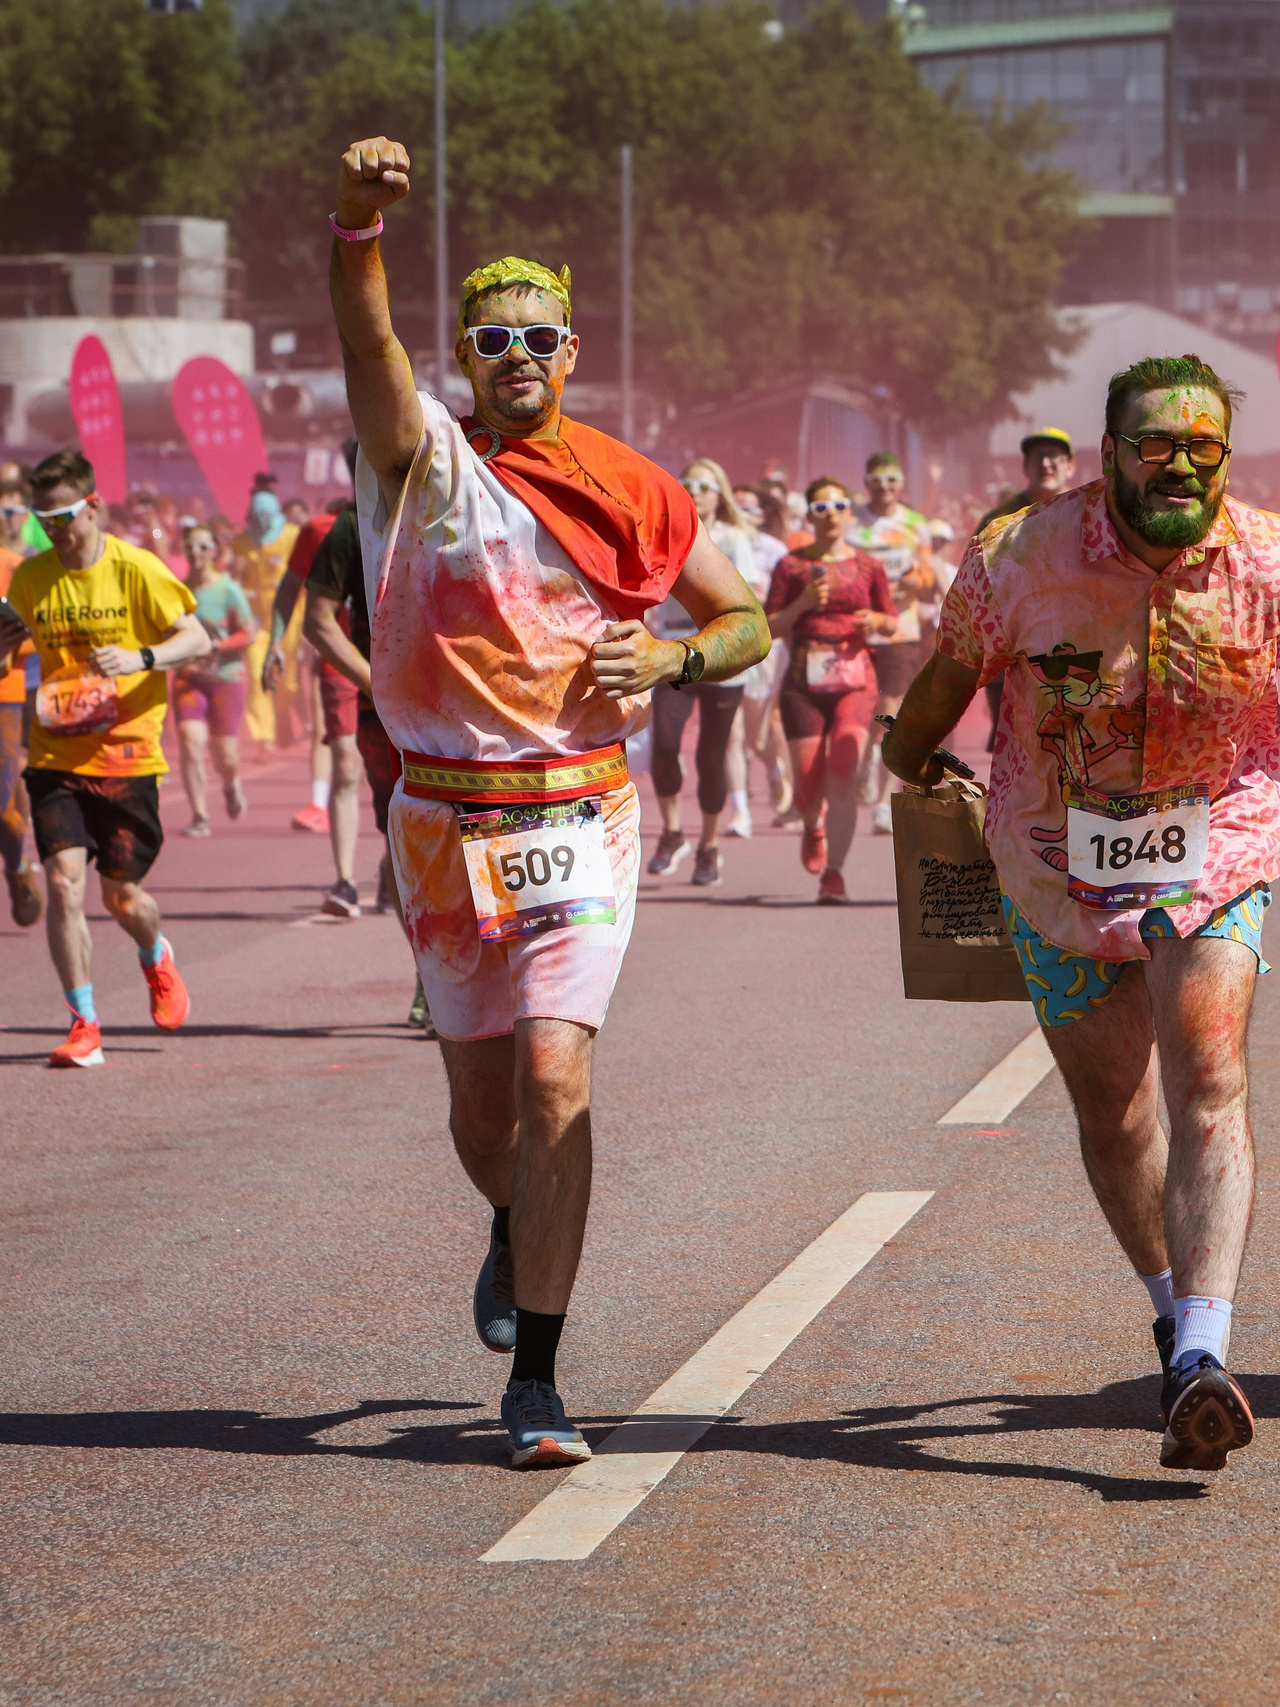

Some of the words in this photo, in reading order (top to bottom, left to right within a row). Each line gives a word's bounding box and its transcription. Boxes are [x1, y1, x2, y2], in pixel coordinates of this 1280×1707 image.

[1083, 783, 1197, 813] КРАСОЧНЫЙ
[1147, 796, 1206, 816] 2026
[1090, 825, 1187, 871] 1848
[500, 845, 575, 892] 509
